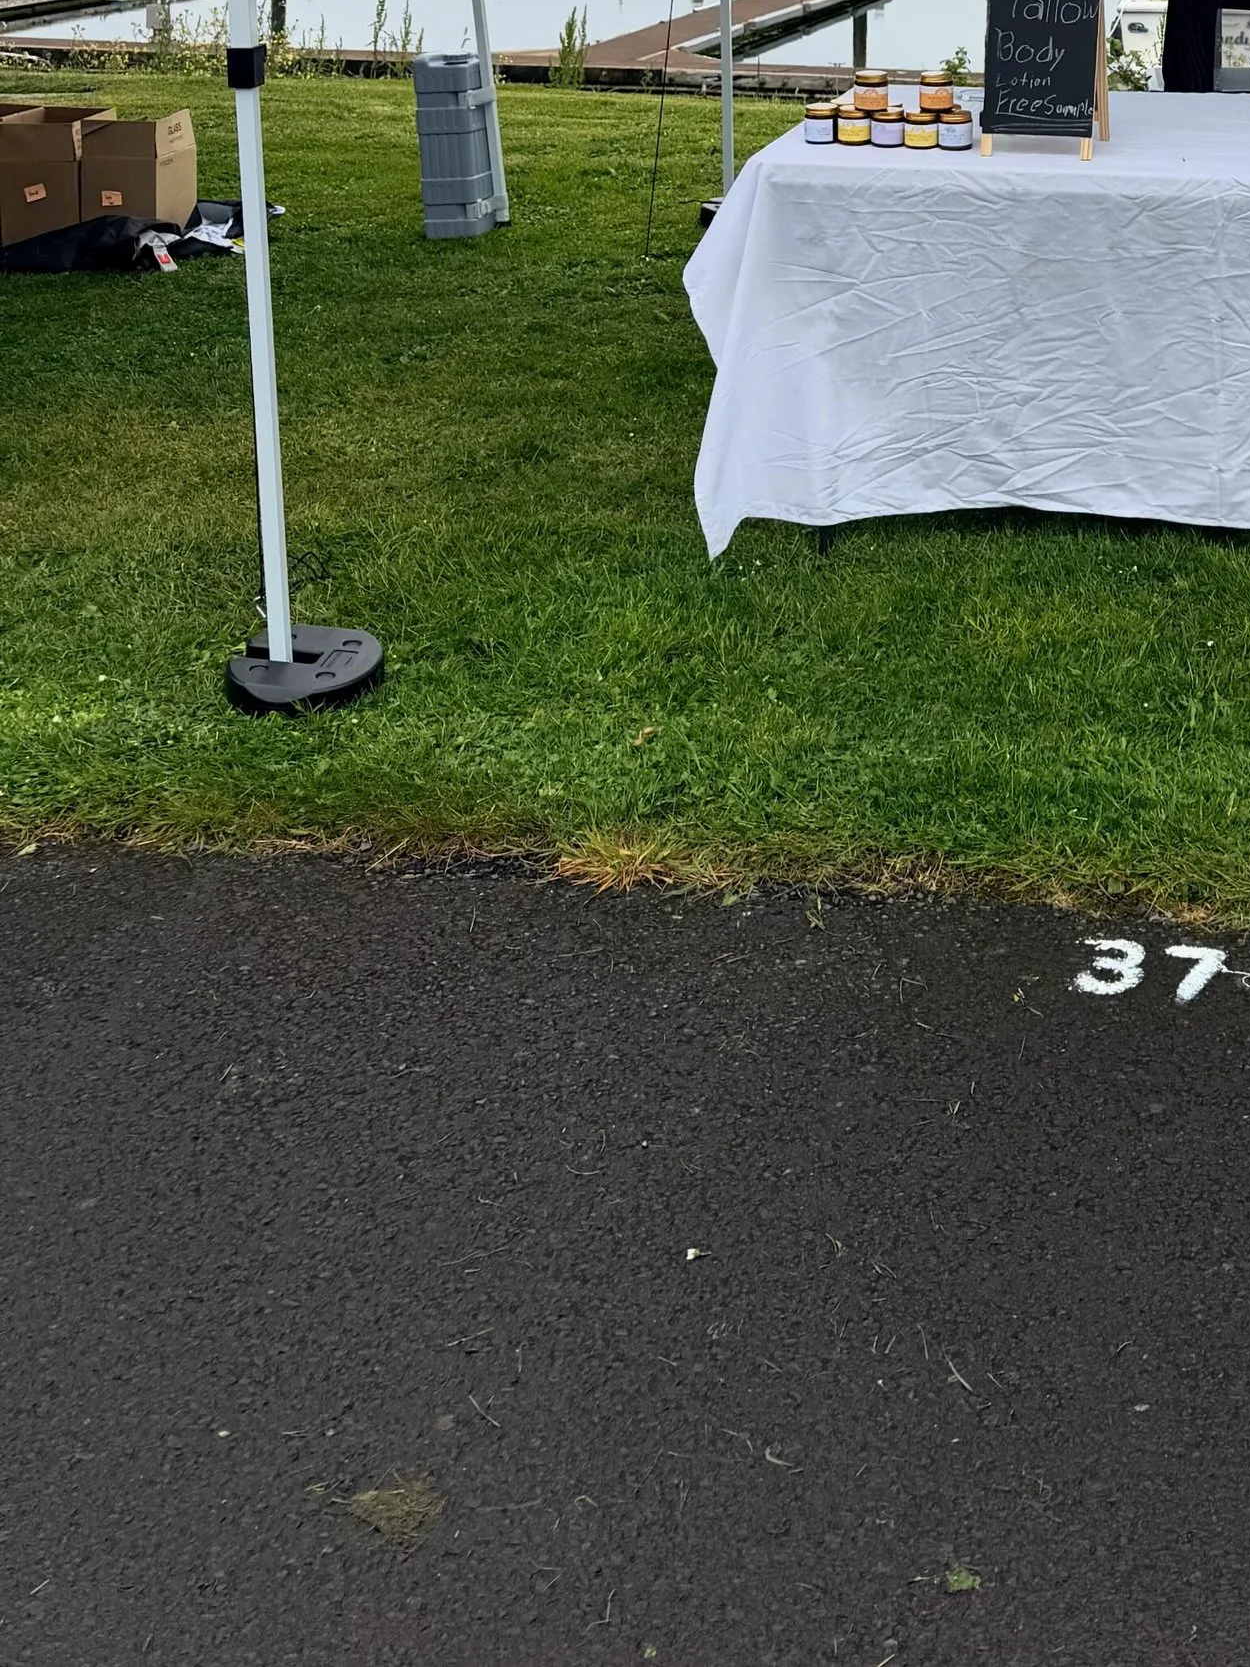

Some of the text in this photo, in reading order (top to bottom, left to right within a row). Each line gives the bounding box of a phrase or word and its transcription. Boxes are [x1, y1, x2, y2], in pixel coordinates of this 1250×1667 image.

[994, 27, 1066, 72] Body
[996, 72, 1051, 89] Lotion
[1072, 938, 1228, 1004] 37
